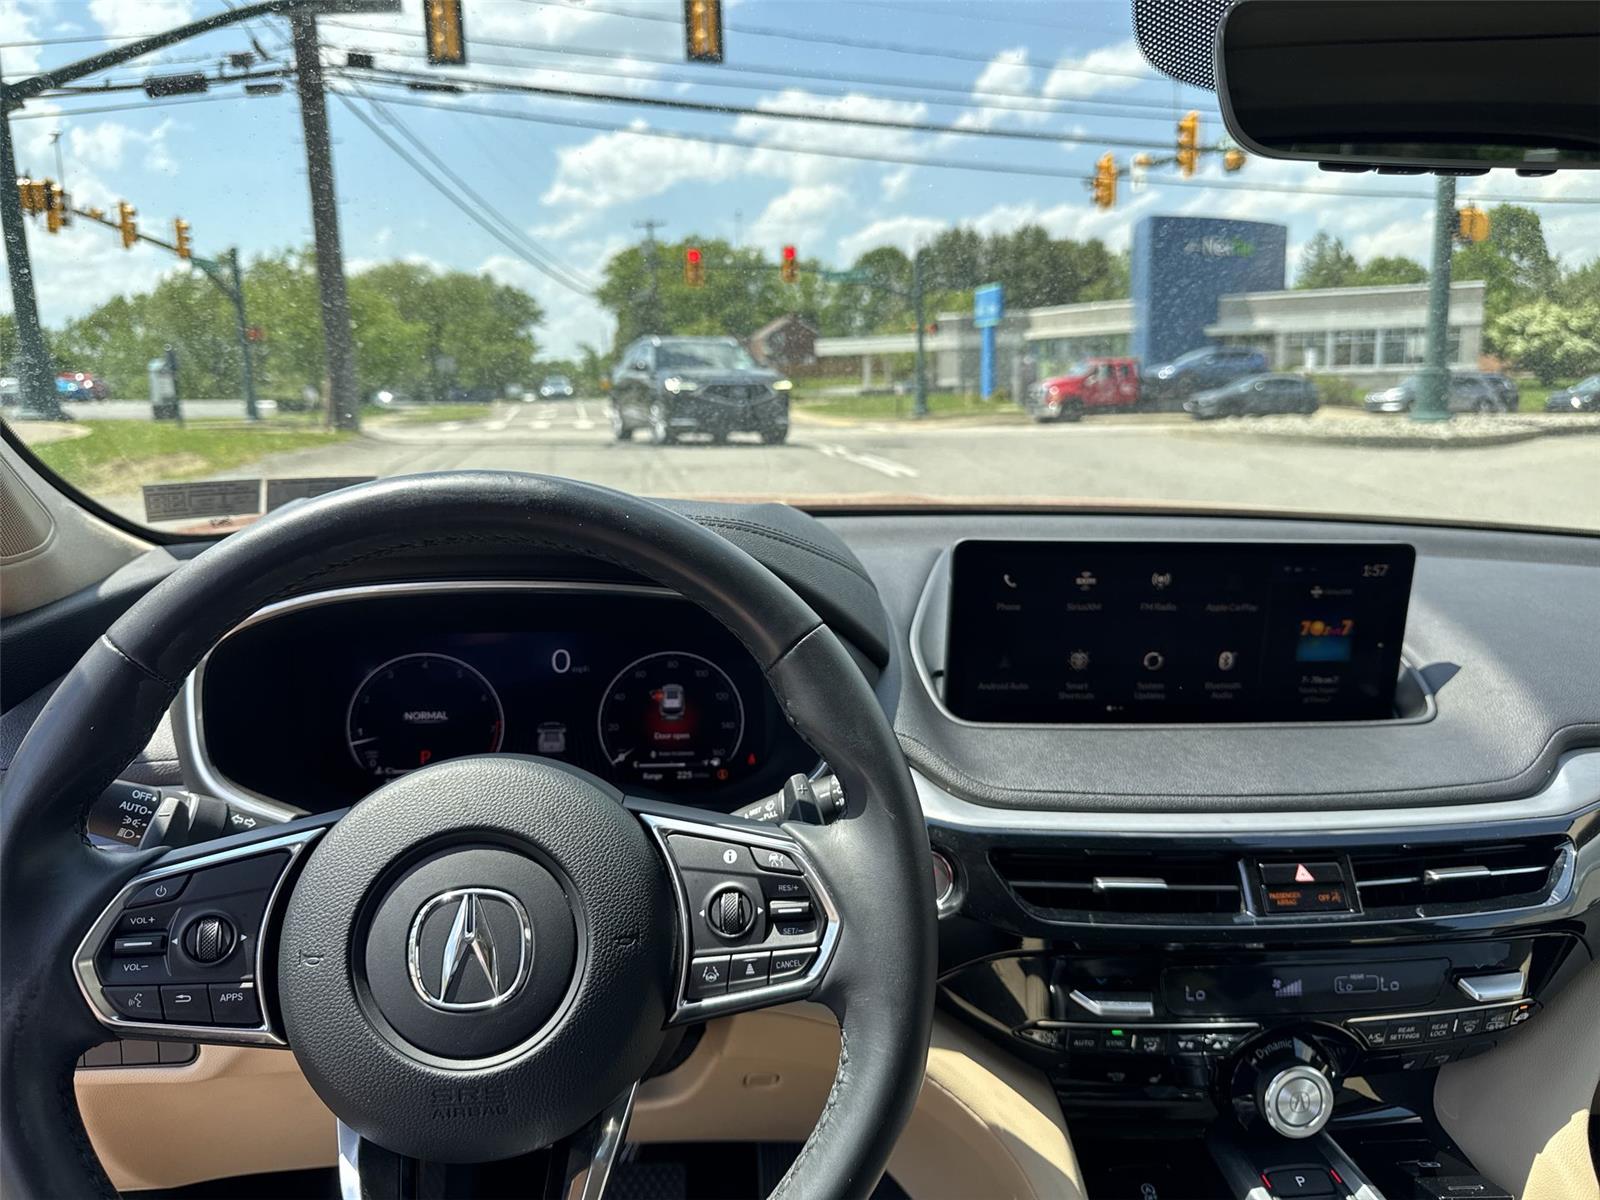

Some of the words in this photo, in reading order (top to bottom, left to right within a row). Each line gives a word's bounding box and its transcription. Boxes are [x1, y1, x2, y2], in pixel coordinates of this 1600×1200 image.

[1362, 564, 1389, 577] 1:57
[551, 648, 571, 674] 0
[403, 711, 449, 721] NORMAL
[653, 732, 671, 741] Door
[672, 732, 691, 743] open
[420, 749, 432, 766] P
[642, 772, 664, 782] Range
[132, 789, 153, 802] OFF
[119, 801, 148, 816] AUTO
[130, 915, 156, 926] VOL+
[776, 959, 801, 969] CANCEL
[219, 992, 244, 1003] APPS
[1397, 1026, 1416, 1034] REAR
[1431, 1023, 1449, 1031] REAR
[1389, 1033, 1421, 1041] SETTINGS
[1429, 1030, 1447, 1038] LOCK
[1073, 1039, 1095, 1047] AUTO
[1105, 1039, 1126, 1048] SYNC
[1254, 1038, 1294, 1061] Dynamic
[1294, 1175, 1306, 1188] P
